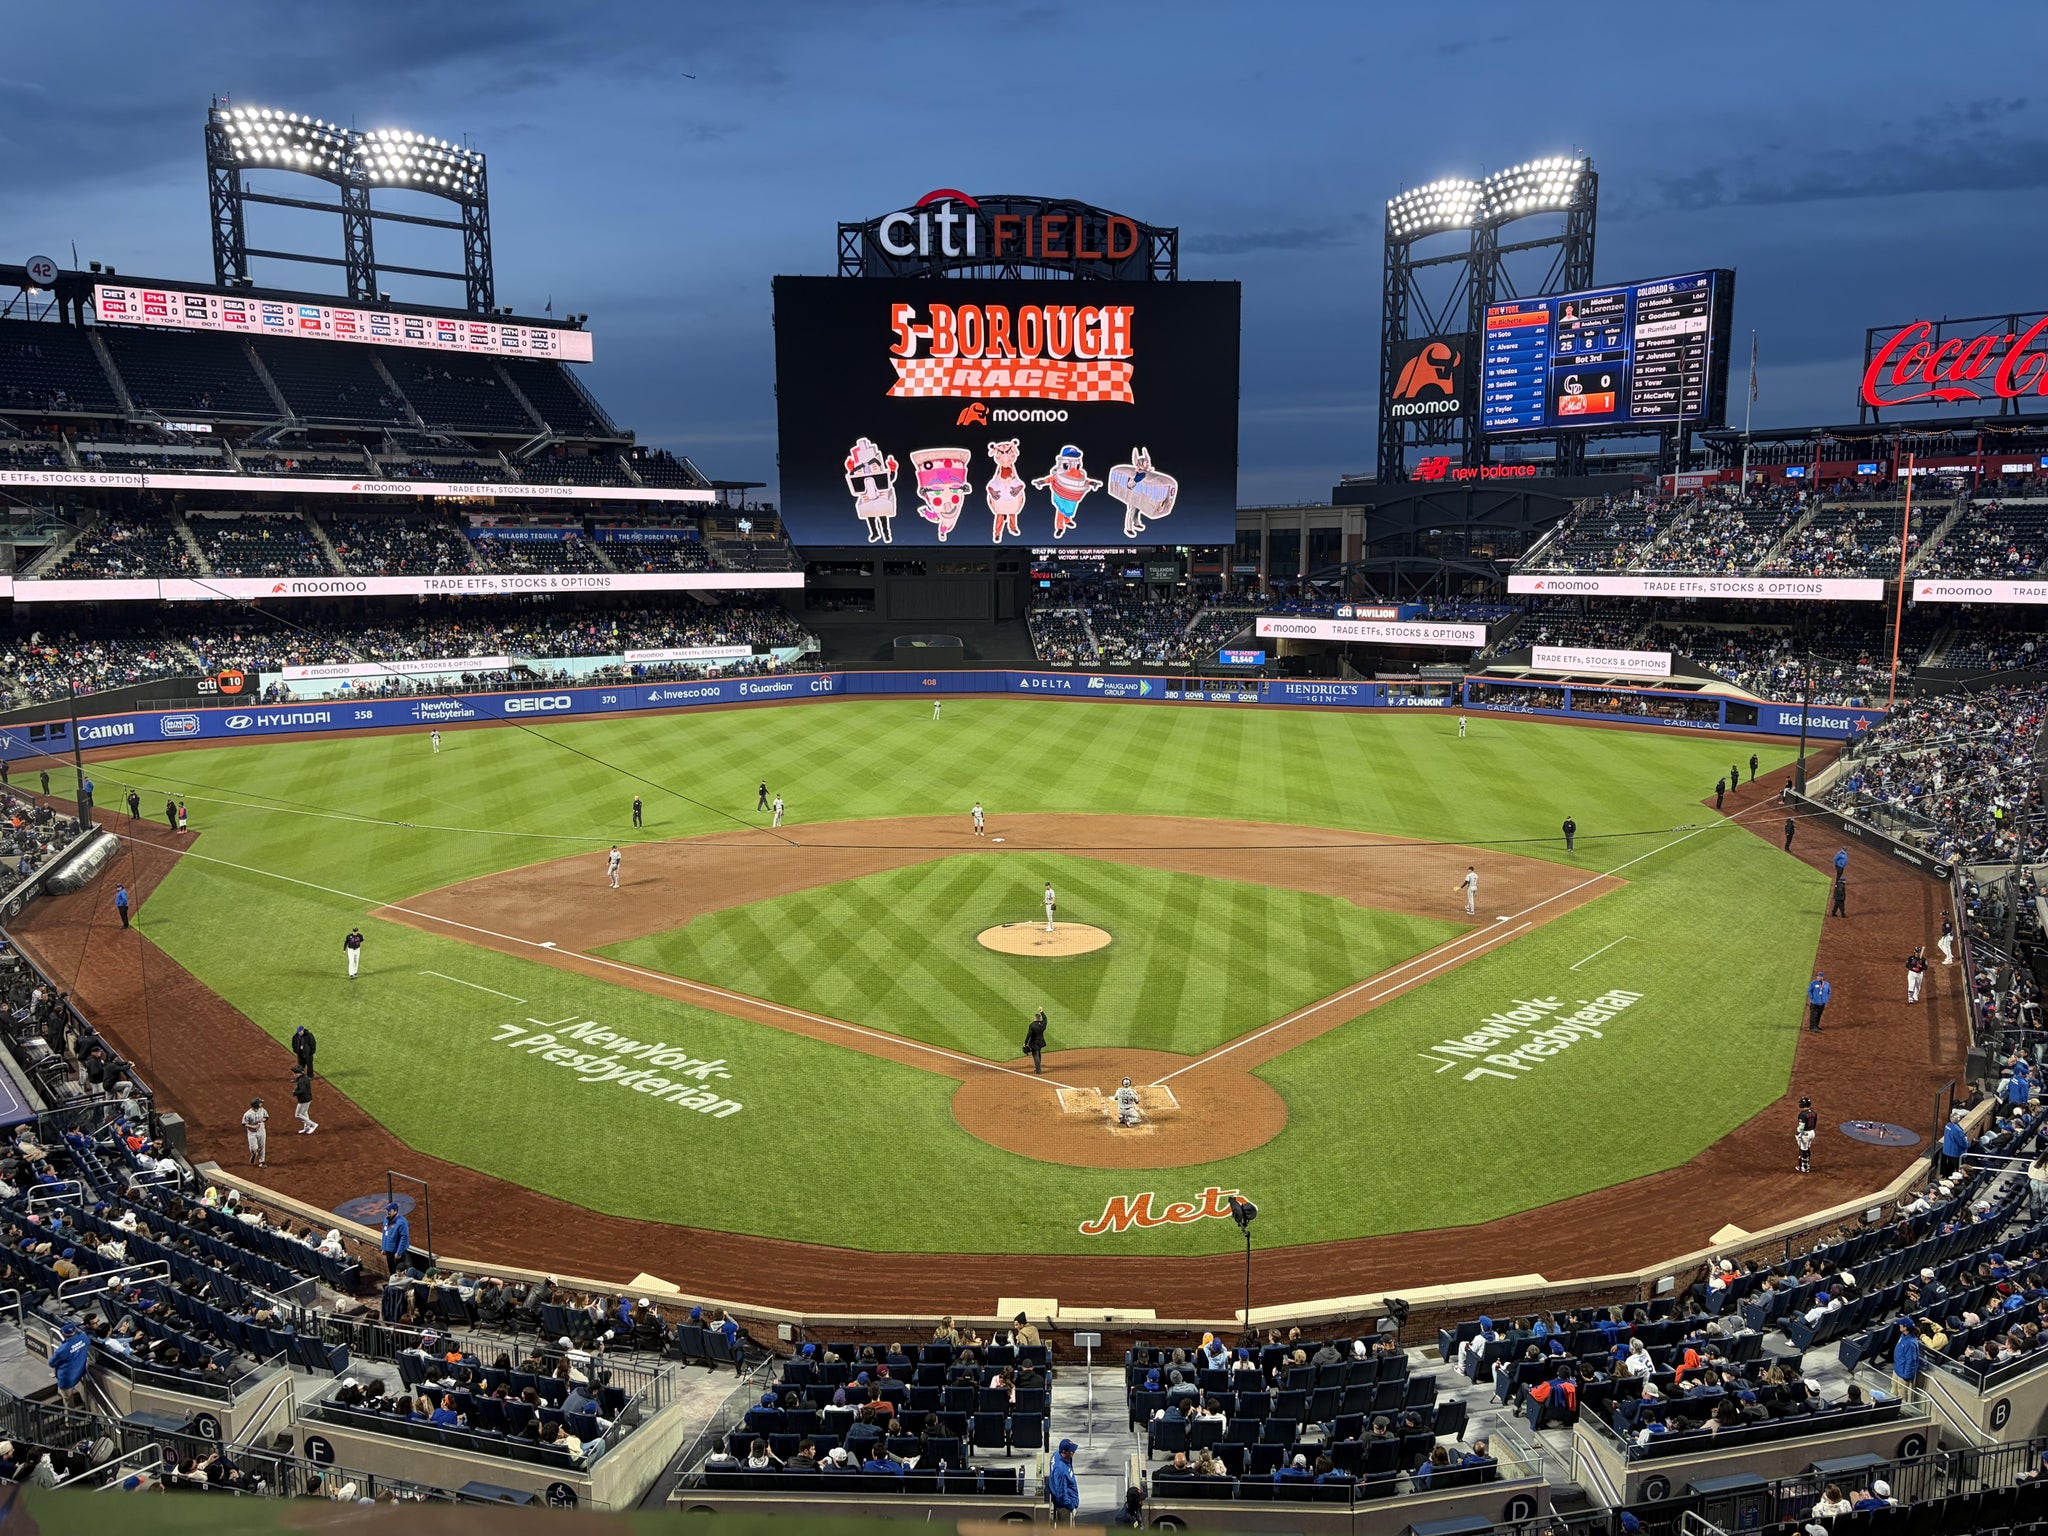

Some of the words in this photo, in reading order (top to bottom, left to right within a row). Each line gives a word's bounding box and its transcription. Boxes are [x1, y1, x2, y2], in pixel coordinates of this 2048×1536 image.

[880, 201, 976, 256] citi
[994, 215, 1137, 259] FIELD
[33, 264, 51, 277] 42
[104, 290, 124, 298] DET
[1638, 284, 1668, 297] COLORADO
[146, 294, 164, 302] PHI
[1590, 298, 1613, 306] Michael
[1649, 298, 1673, 307] Moniak
[188, 310, 206, 318] MIL
[263, 305, 282, 313] CHC
[1590, 304, 1624, 313] Lorenzen
[1648, 311, 1680, 320] Goodman
[890, 304, 1134, 359] 5-BOROUGH
[1648, 324, 1676, 334] Rumfield
[1586, 339, 1592, 348] 8
[1608, 336, 1617, 345] 17
[1647, 338, 1675, 347] Freeman
[1561, 342, 1572, 351] 25
[1576, 356, 1588, 364] Bot
[1590, 354, 1602, 362] 3rd
[1646, 352, 1676, 360] Johnston
[952, 369, 1068, 390] RACE
[1601, 375, 1610, 388] 0
[1604, 395, 1609, 408] 1
[1643, 392, 1675, 400] McCarthy
[1392, 399, 1459, 416] moomoo
[993, 409, 1068, 422] moomoo
[1494, 417, 1519, 425] Mauricio
[1452, 467, 1477, 478] new
[1480, 464, 1536, 477] balance
[11, 474, 39, 483] ETFs,
[42, 474, 86, 483] STOCKS
[100, 475, 150, 484] OPTIONS
[364, 483, 412, 492] moomoo
[448, 485, 475, 494] TRADE
[476, 485, 497, 495] ETFs,
[499, 486, 530, 494] STOCKS
[539, 487, 573, 495] OPTIONS
[292, 581, 367, 593] moomoo
[424, 579, 465, 589] TRADE
[468, 579, 498, 589] ETFs,
[501, 578, 547, 588] STOCKS
[550, 578, 558, 587] &
[561, 577, 611, 587] OPTIONS
[1548, 581, 1599, 591] moomoo
[1644, 582, 1676, 591] TRADE
[1679, 582, 1707, 592] ETFs,
[1710, 583, 1754, 592] STOCKS
[1758, 583, 1765, 592] &
[1768, 583, 1822, 593] OPTIONS
[1936, 586, 1992, 596] moomoo
[2013, 587, 2048, 596] TRADE
[1337, 608, 1352, 617] citi
[1356, 608, 1395, 618] PAVILION
[1274, 624, 1317, 634] moomoo
[1332, 626, 1358, 635] TRADE
[1361, 627, 1382, 637] ETFs,
[1386, 627, 1421, 637] STOCKS
[1423, 629, 1430, 637] &
[1432, 629, 1475, 639] OPTIONS
[1231, 656, 1253, 664] $1,540
[1537, 654, 1561, 662] TRADE
[1563, 655, 1584, 664] ETFs,
[1586, 656, 1618, 665] STOCKS
[1628, 659, 1666, 668] OPTIONS
[198, 680, 216, 690] citi
[750, 683, 793, 694] Guardian
[811, 679, 832, 691] citi
[1032, 679, 1071, 689] DELTA
[1286, 684, 1358, 695] HENDRICK'S
[664, 689, 699, 700] Invesco
[701, 687, 720, 697] QQQ
[1211, 692, 1230, 700] GOYA
[504, 696, 571, 713] GEICO
[602, 696, 616, 704] 370
[1407, 697, 1444, 707] DUNKIN'
[421, 702, 462, 712] NewYork-
[1486, 704, 1534, 714] CADILLAC
[258, 712, 330, 726] HYUNDAI
[355, 711, 372, 719] 358
[421, 709, 474, 720] Presbyterian
[1664, 719, 1720, 730] CADILLAC
[1779, 712, 1849, 730] Heineken
[78, 723, 134, 740] Canon
[1430, 996, 1564, 1058] NewYork-
[1483, 989, 1644, 1070] Presbyterian
[556, 1020, 733, 1080] NewYork-
[508, 1034, 742, 1118] Presbyterian
[1996, 1405, 2006, 1424] B
[200, 1419, 215, 1438] G
[312, 1442, 324, 1460] F
[1904, 1442, 1919, 1459] C
[1647, 1481, 1663, 1501] C
[1512, 1501, 1529, 1520] D
